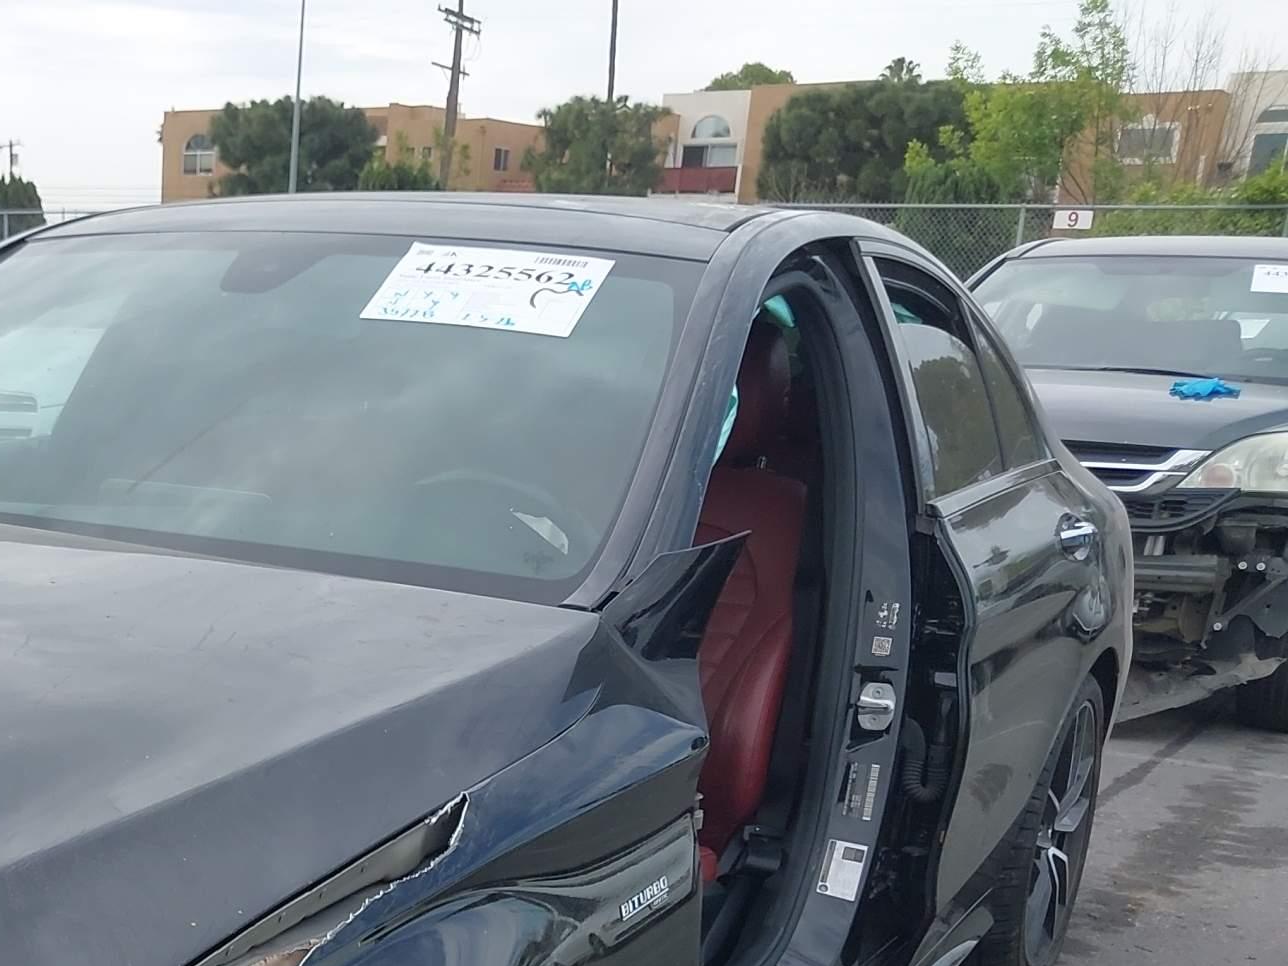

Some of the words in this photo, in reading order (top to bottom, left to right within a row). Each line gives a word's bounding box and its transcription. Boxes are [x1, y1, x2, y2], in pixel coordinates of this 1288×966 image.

[1067, 211, 1079, 228] 9
[415, 262, 575, 286] 44325562
[621, 875, 669, 917] BITURBO
